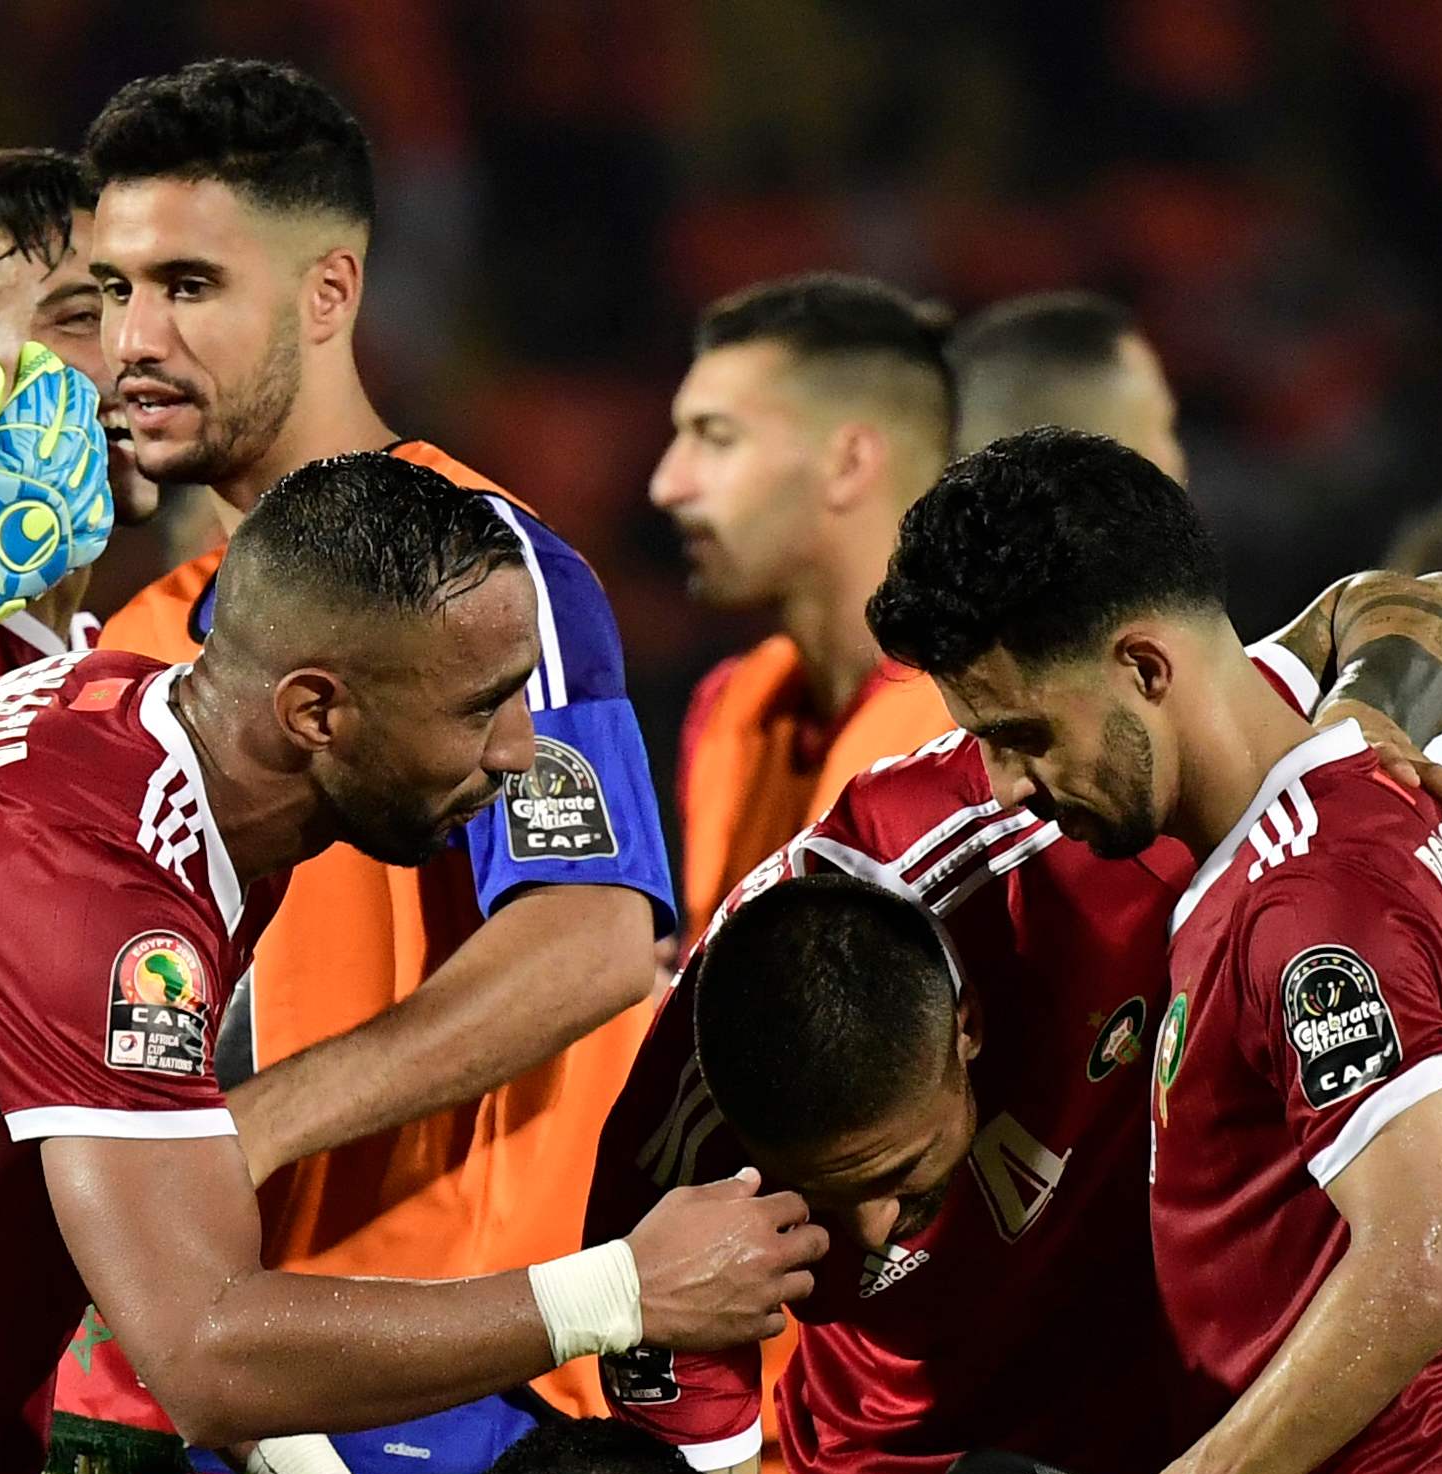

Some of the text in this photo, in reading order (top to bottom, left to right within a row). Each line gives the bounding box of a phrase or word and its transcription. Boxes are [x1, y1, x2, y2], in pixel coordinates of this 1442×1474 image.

[527, 832, 592, 849] CAF
[131, 938, 174, 958] EGYPT
[131, 1007, 191, 1028] CAF
[1293, 1000, 1381, 1052] Celebrate
[147, 1032, 180, 1047] AFRICA
[1311, 1022, 1368, 1060] Africa
[147, 1045, 166, 1055] CUP
[146, 1056, 159, 1067] OF
[158, 1057, 194, 1072] NATIONS
[1319, 1053, 1384, 1091] CAF
[859, 1249, 930, 1299] adidas
